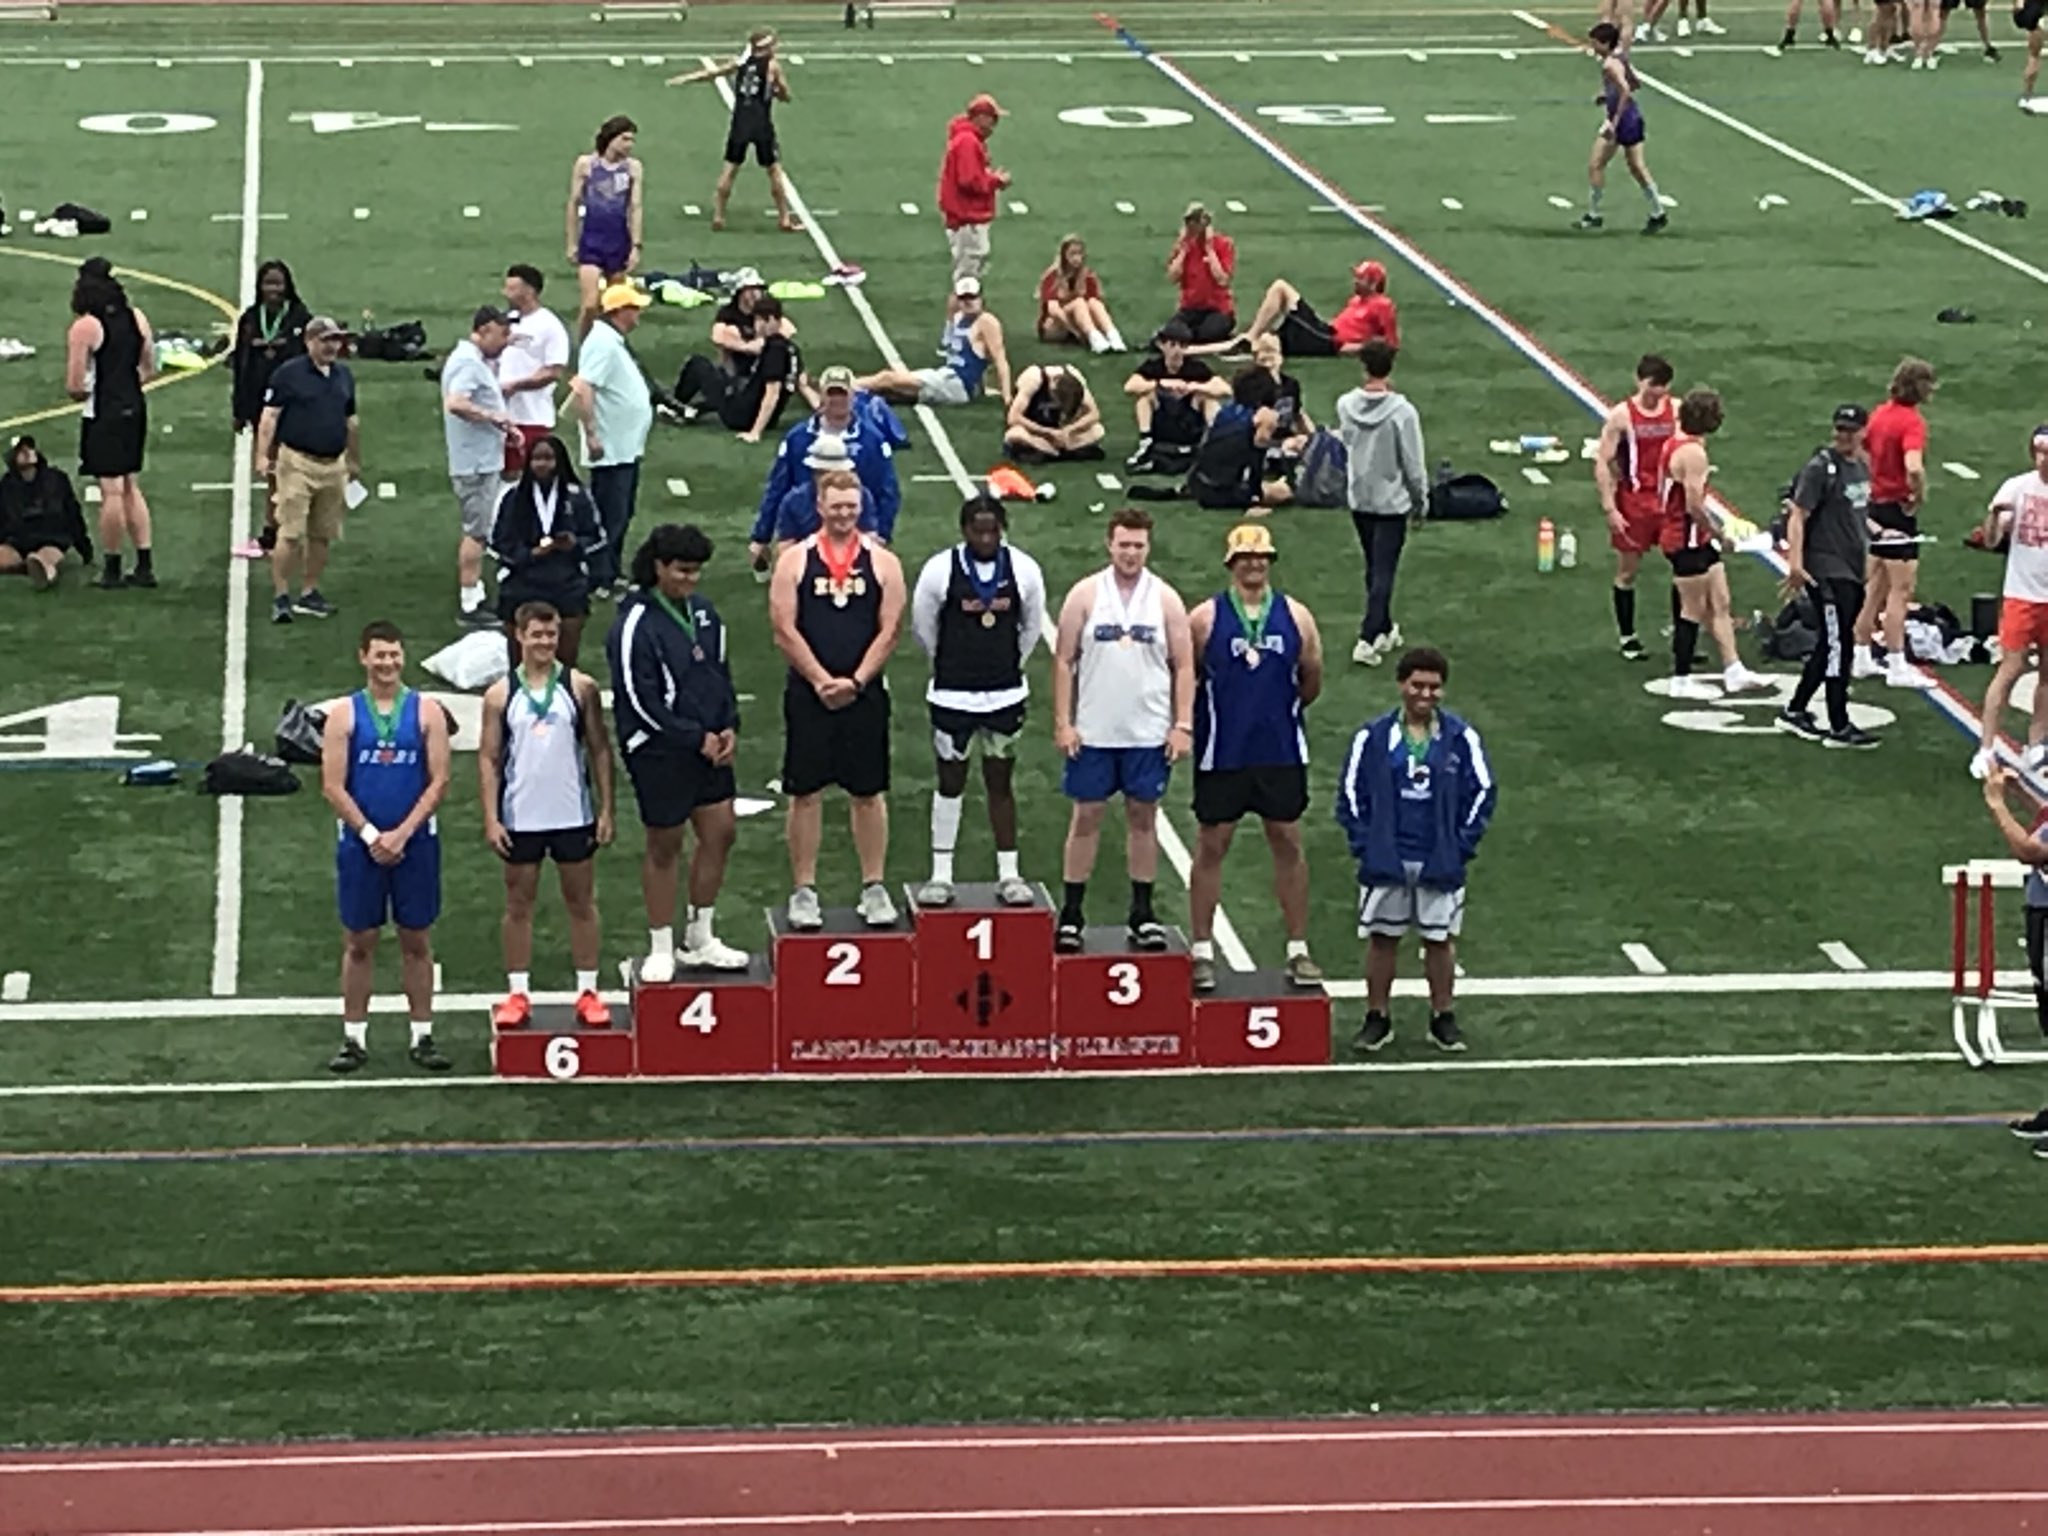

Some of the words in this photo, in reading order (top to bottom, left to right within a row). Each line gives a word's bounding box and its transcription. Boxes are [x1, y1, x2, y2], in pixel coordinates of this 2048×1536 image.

[966, 918, 993, 960] 1
[824, 942, 862, 985] 2
[1107, 962, 1141, 1004] 3
[680, 991, 717, 1033] 4
[1246, 1006, 1281, 1049] 5
[544, 1036, 580, 1078] 6
